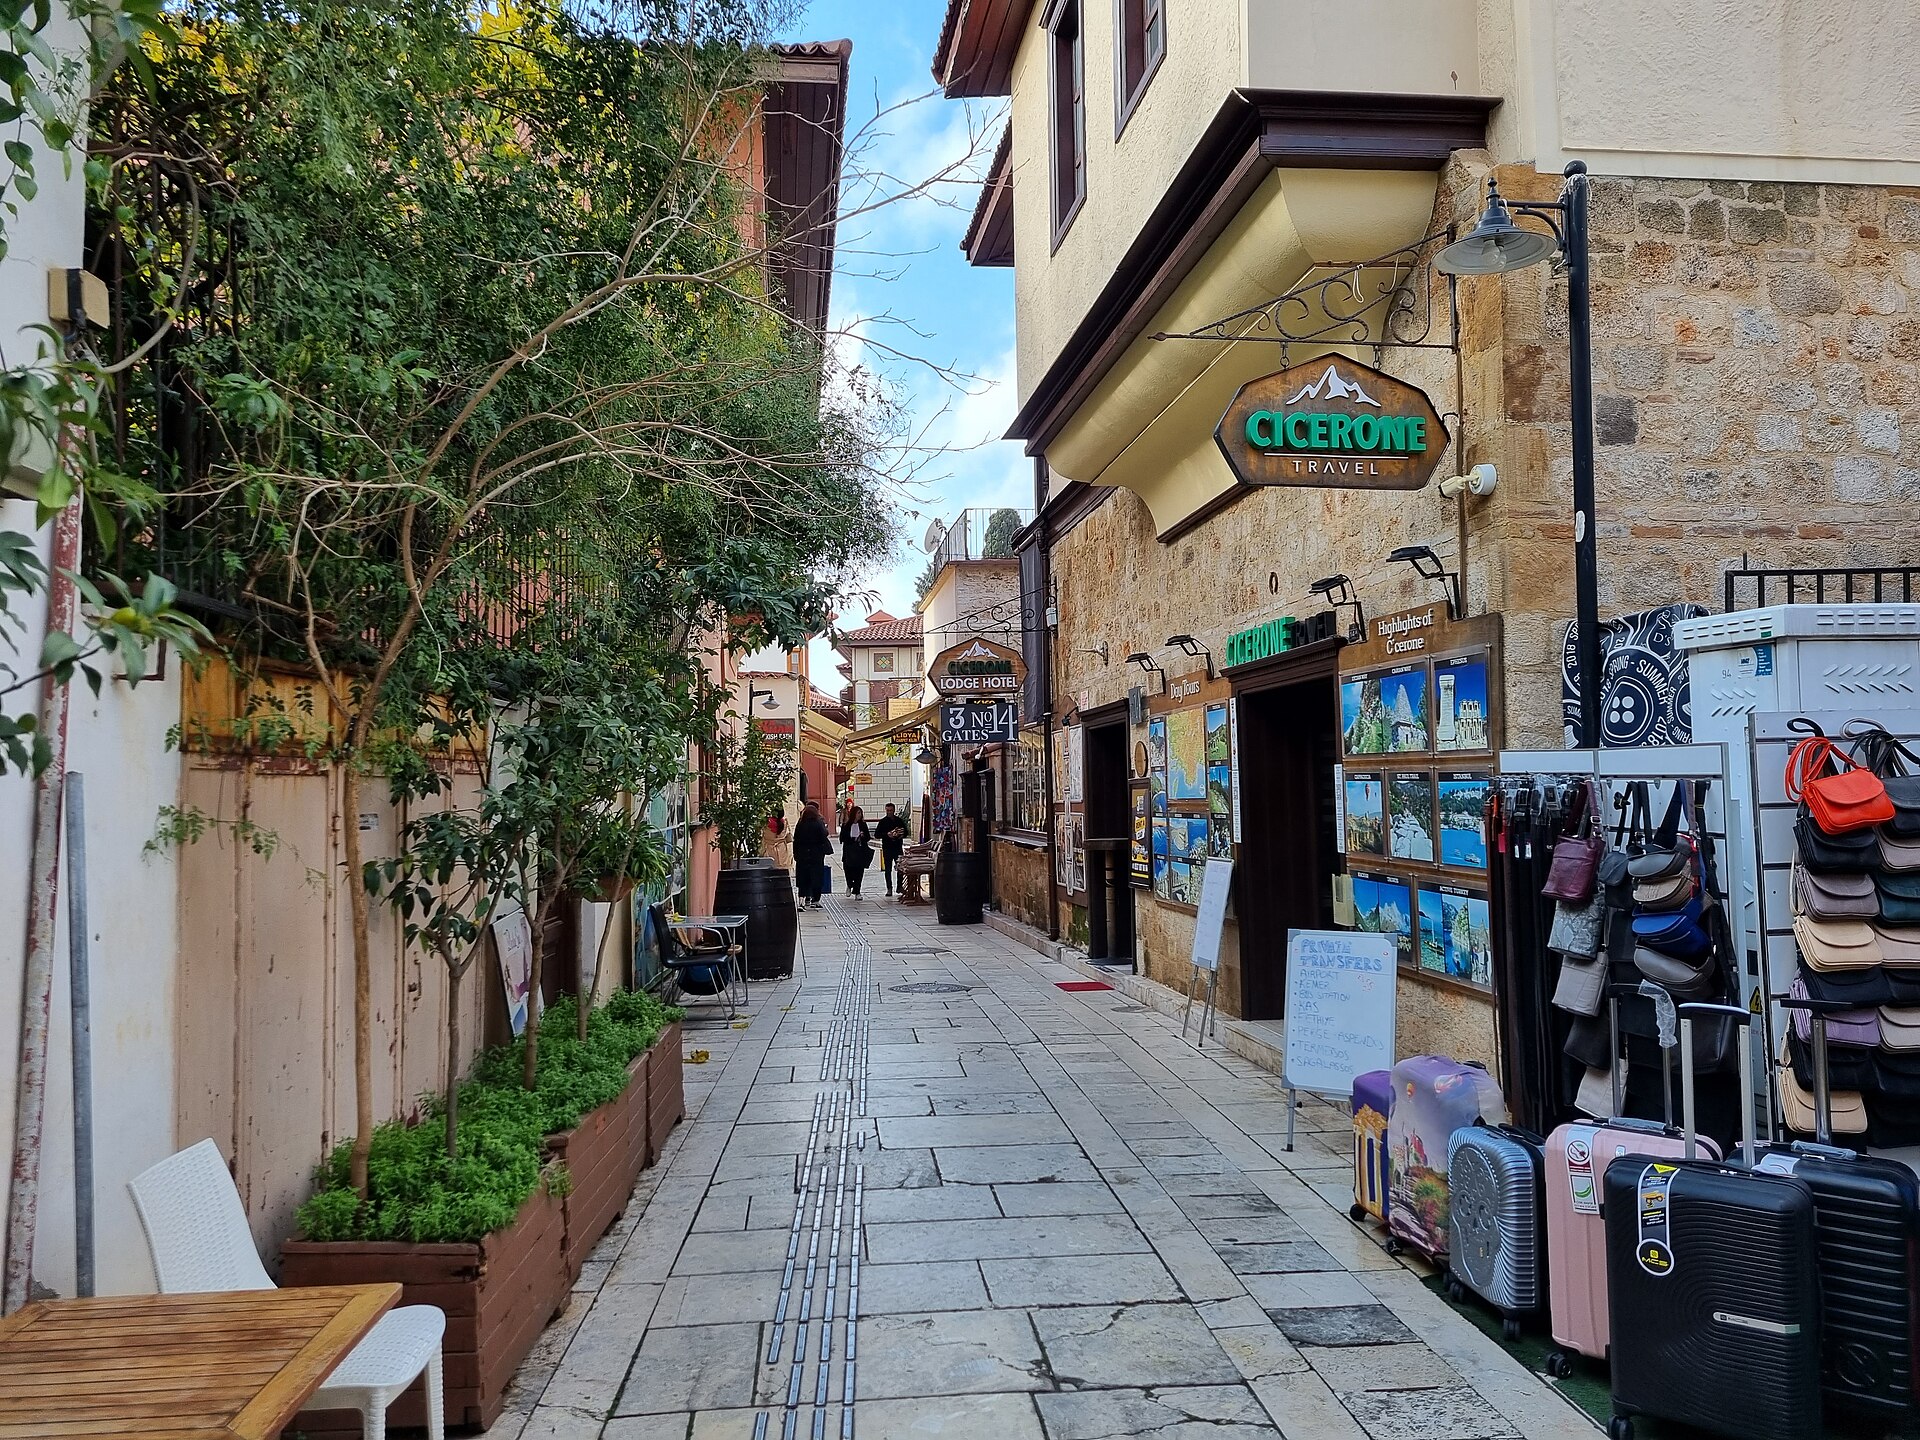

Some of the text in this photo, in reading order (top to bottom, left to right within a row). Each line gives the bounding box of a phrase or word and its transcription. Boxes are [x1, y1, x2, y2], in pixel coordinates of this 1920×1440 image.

[1246, 410, 1427, 454] CICERONE
[1292, 460, 1379, 475] TRAVEL
[1377, 613, 1422, 638] Highlights
[1422, 608, 1434, 626] of
[1226, 616, 1296, 666] CICERONE
[1566, 644, 1578, 669] 2018
[940, 676, 1019, 690] LODGE HOTEL
[1170, 679, 1201, 703] Day Tours
[1636, 659, 1669, 705] SUMMER
[949, 707, 965, 729] 3
[942, 729, 989, 741] GATES
[1301, 939, 1352, 954] PRIVATE
[1300, 954, 1383, 971] TRANSFERS
[1300, 968, 1340, 980] AIRPORT
